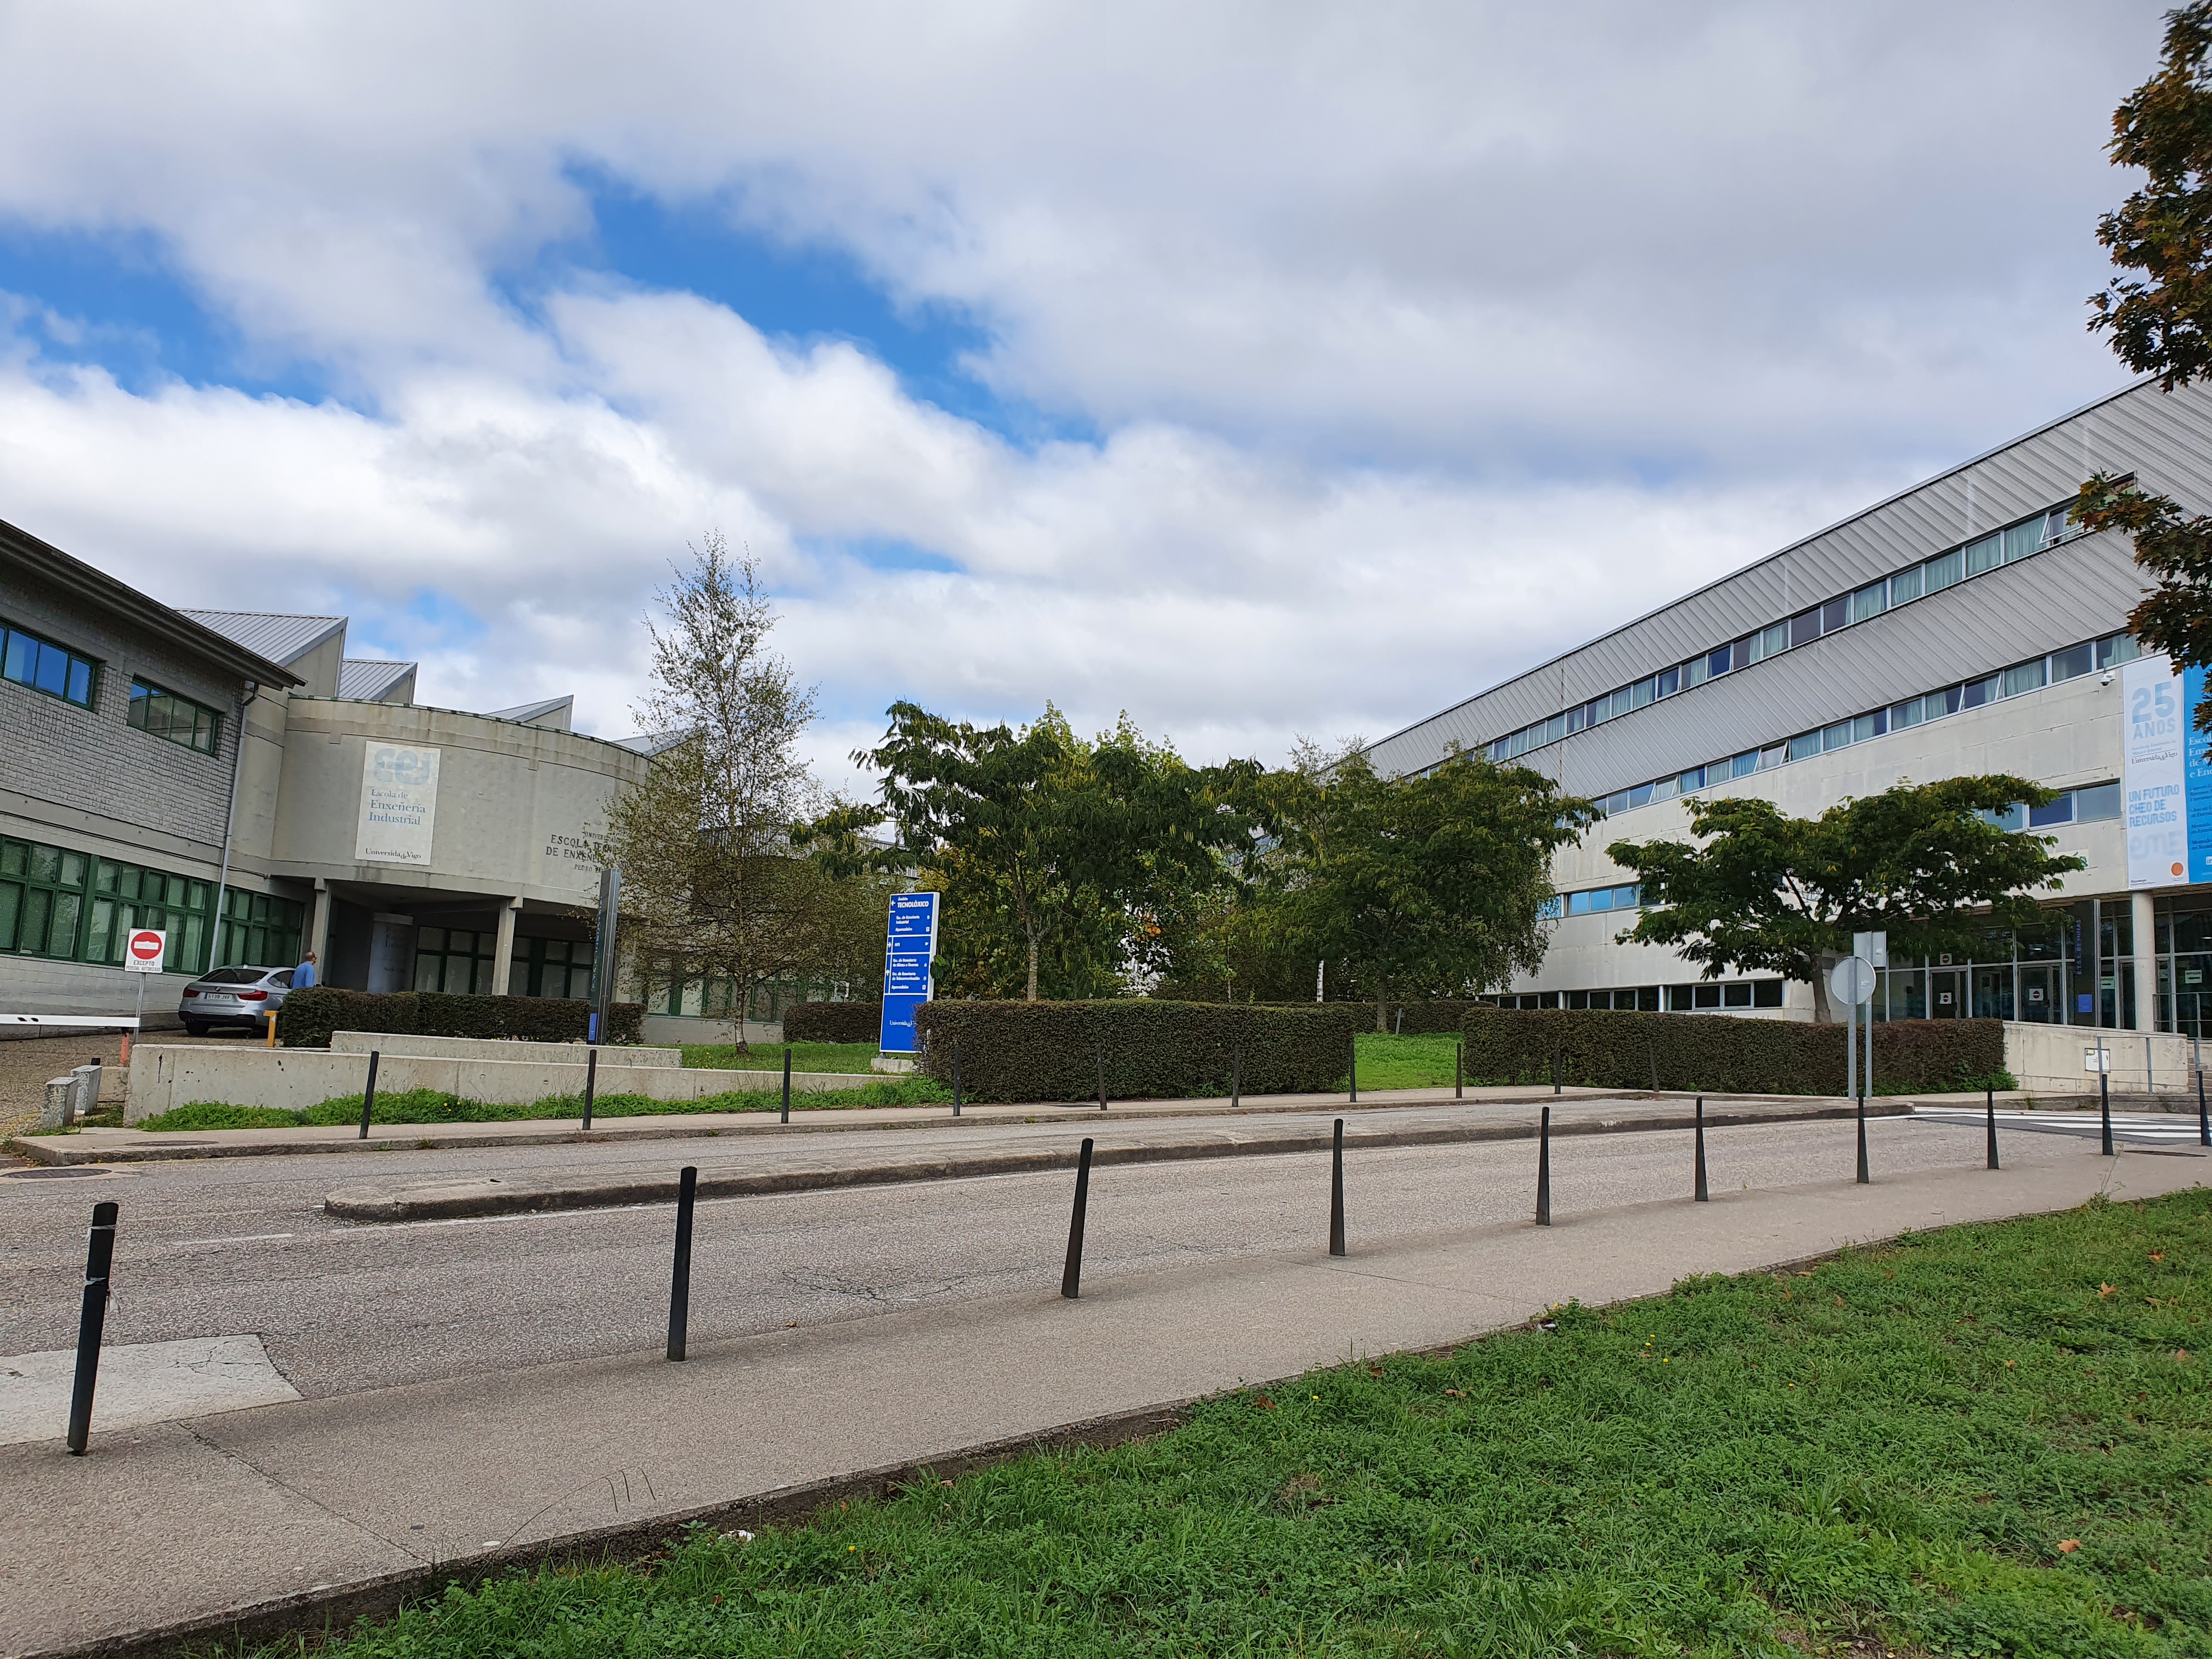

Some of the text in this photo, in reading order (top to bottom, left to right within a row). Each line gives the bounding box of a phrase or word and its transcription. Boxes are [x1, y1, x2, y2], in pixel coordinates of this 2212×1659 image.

[2132, 681, 2175, 724] 25
[2132, 717, 2176, 740] ANOS
[371, 789, 396, 798] Escola
[2129, 791, 2141, 802] UN
[2143, 785, 2180, 800] FUTURO
[2129, 799, 2166, 815] CHEO DE
[369, 811, 421, 825] Industrial
[2130, 811, 2177, 827] RECURSOS
[545, 845, 558, 856] DE
[897, 900, 929, 908] TECNOLÓXICO
